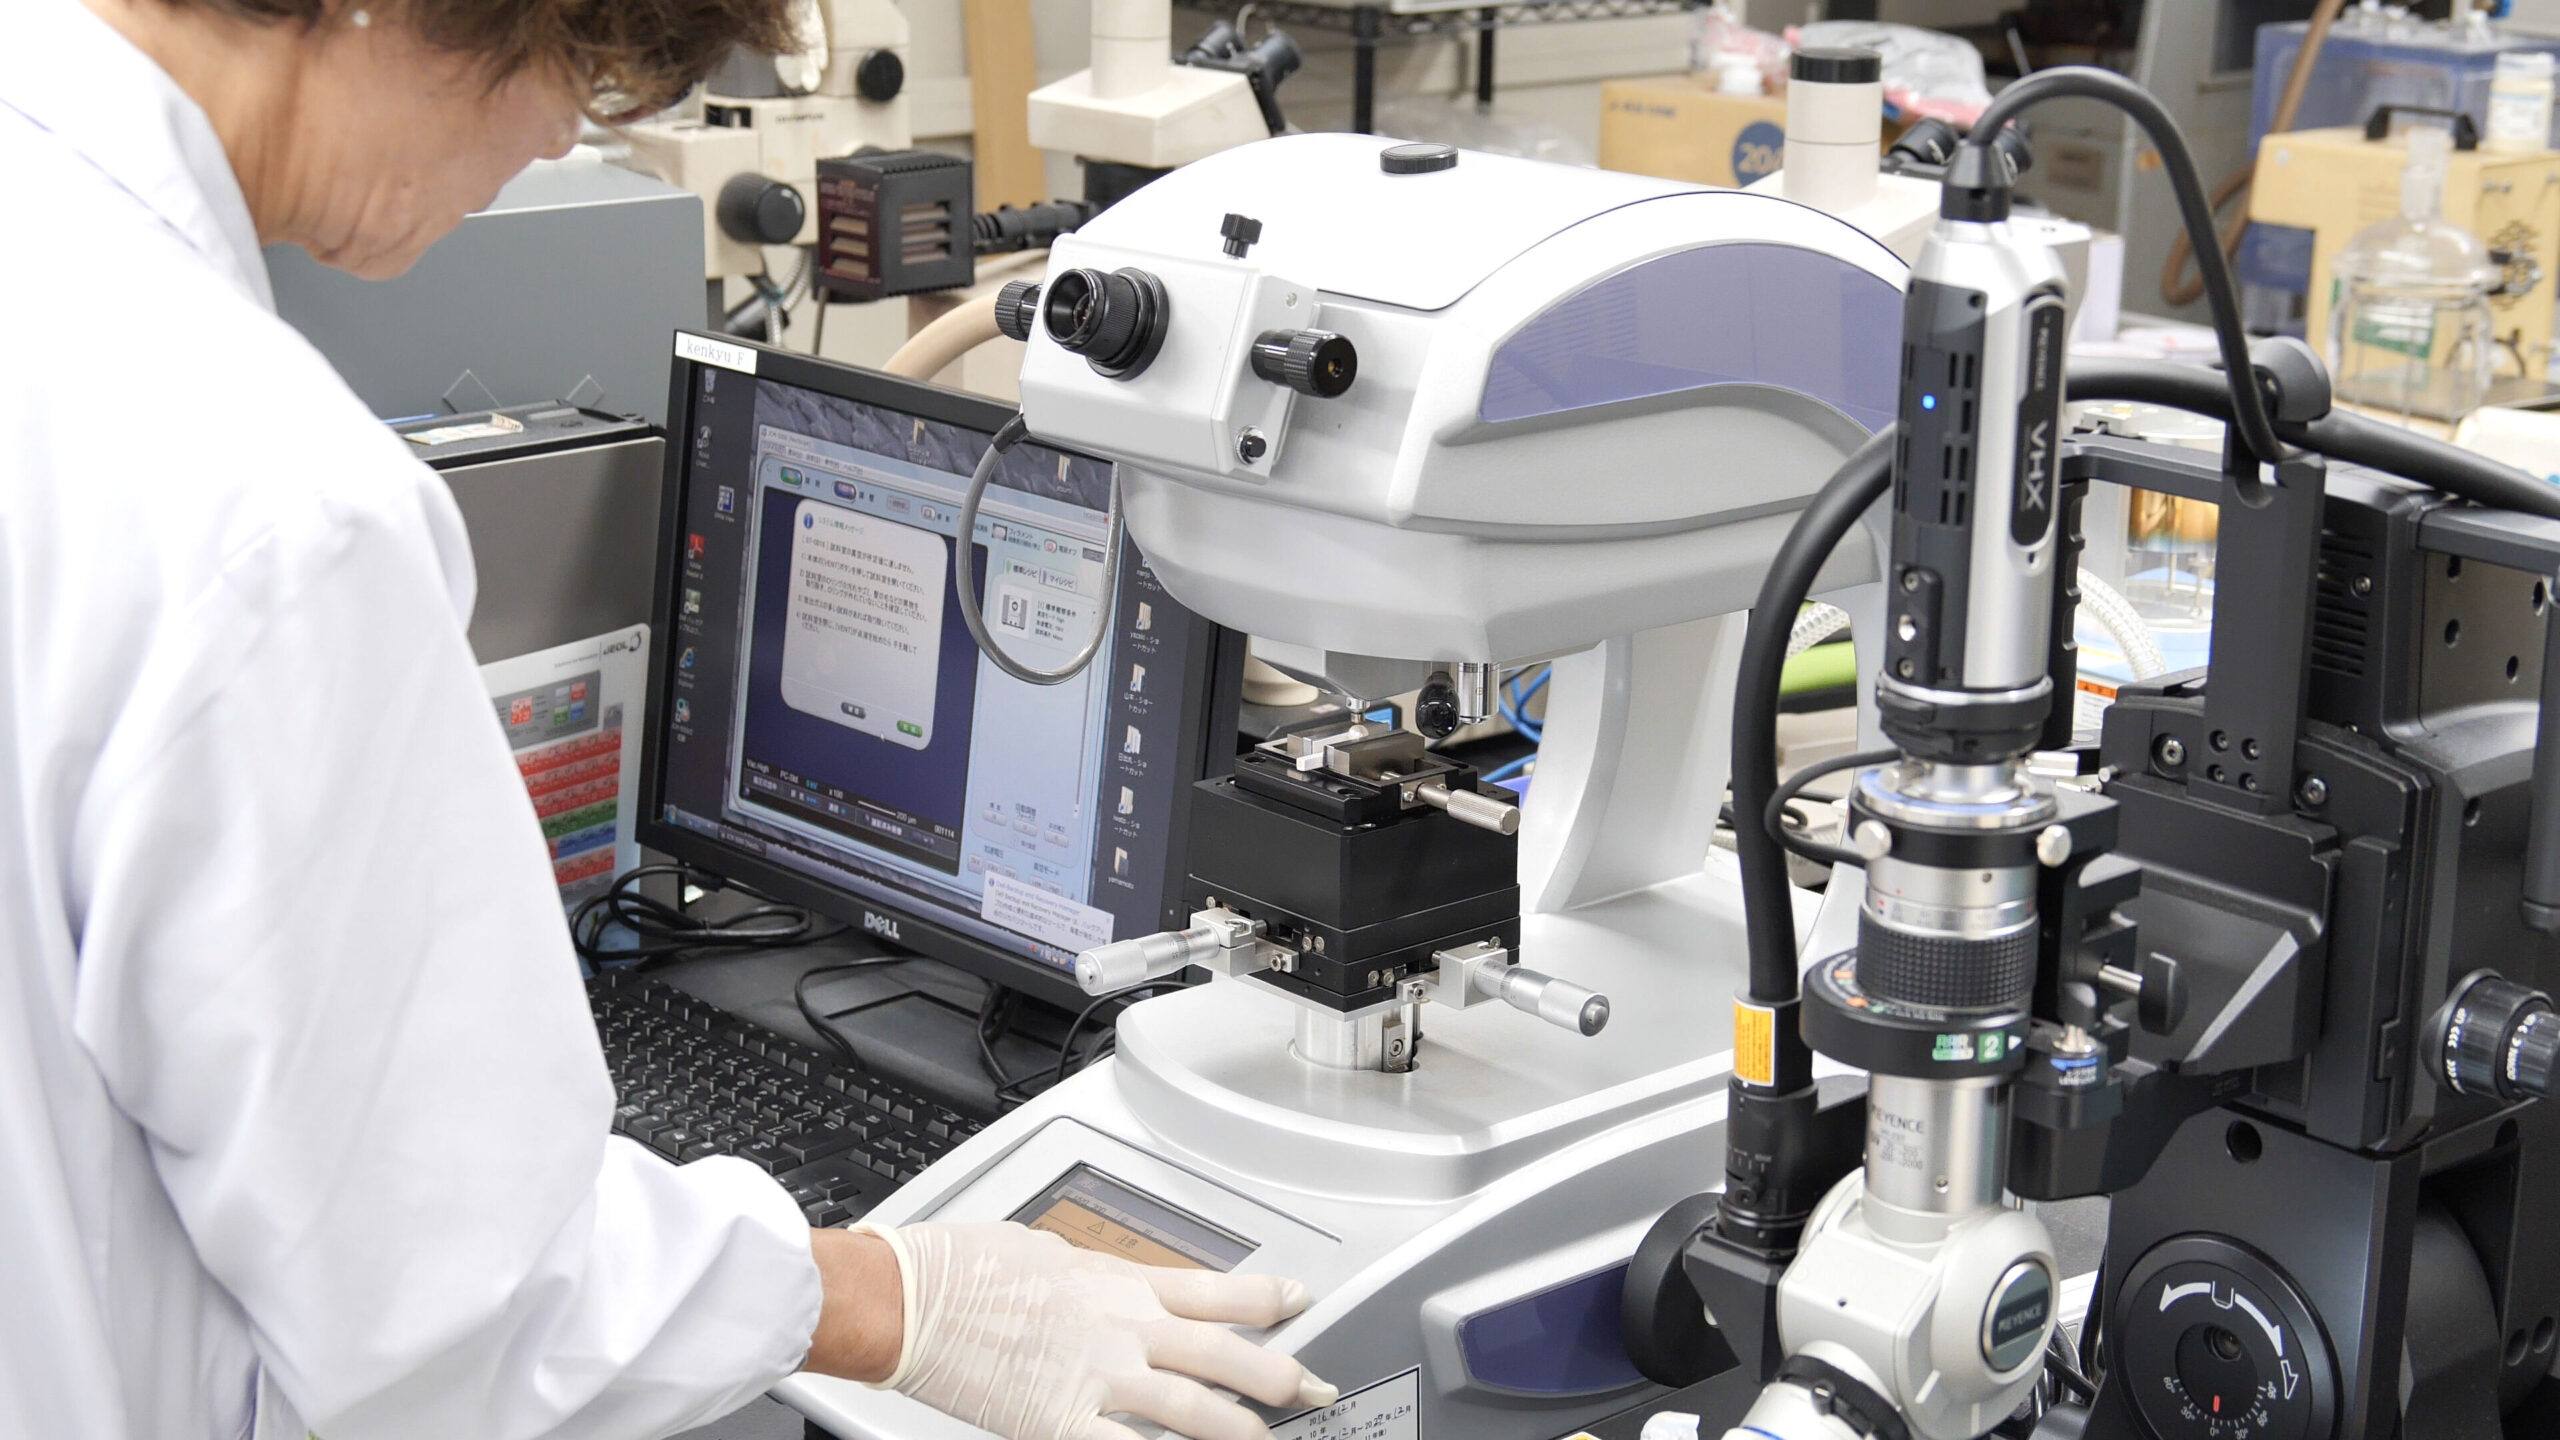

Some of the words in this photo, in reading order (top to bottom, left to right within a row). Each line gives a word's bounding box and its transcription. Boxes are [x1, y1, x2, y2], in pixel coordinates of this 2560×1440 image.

[687, 339, 731, 363] kenkyu
[737, 352, 745, 365] F
[2027, 420, 2048, 512] VHX
[864, 911, 900, 939] DELL
[1984, 1035, 1999, 1058] 2
